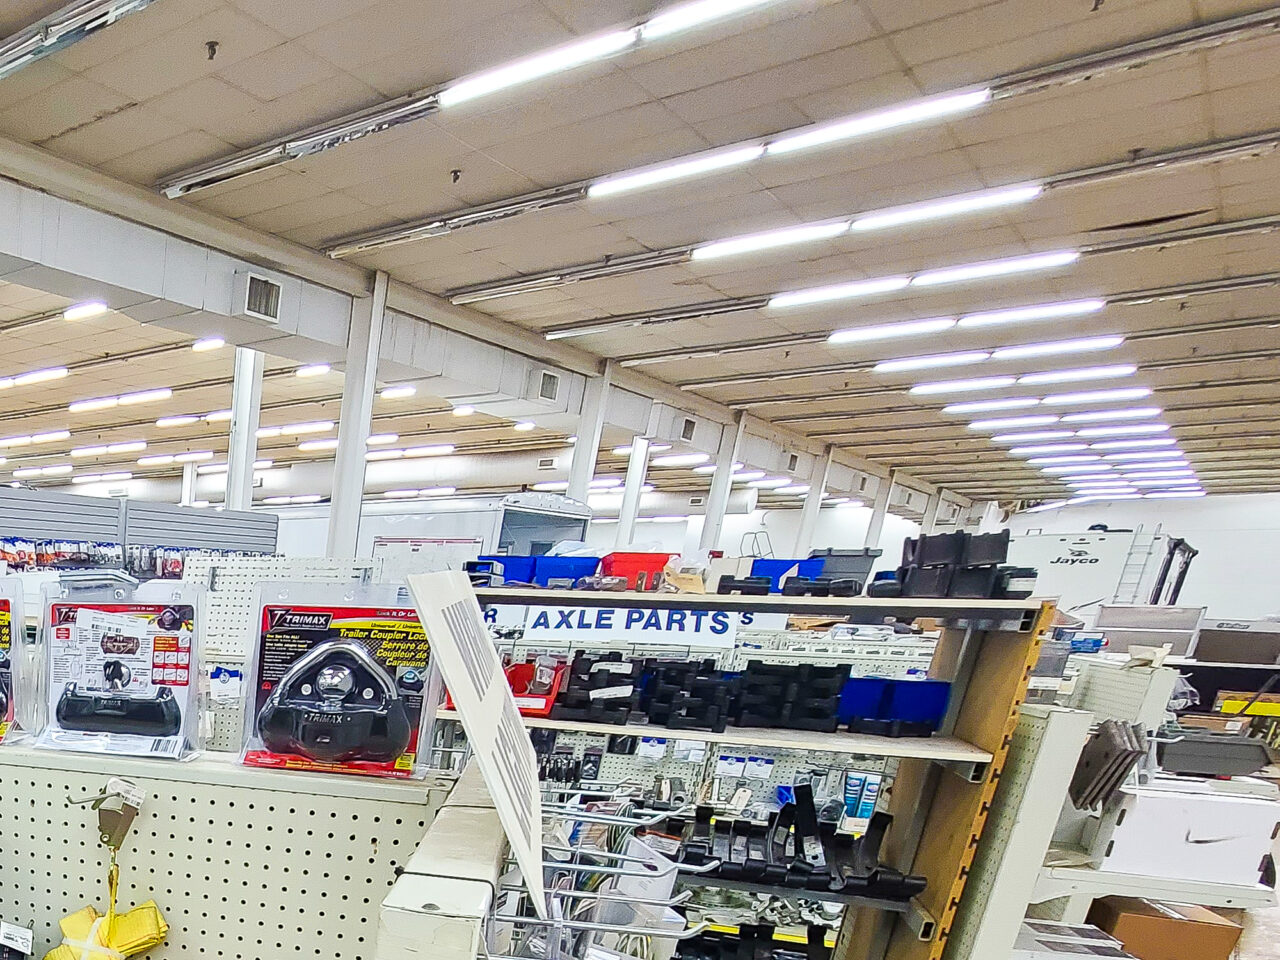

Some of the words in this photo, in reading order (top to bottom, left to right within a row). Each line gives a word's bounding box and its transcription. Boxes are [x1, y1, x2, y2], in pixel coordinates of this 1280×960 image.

[1049, 556, 1100, 566] Jayco
[285, 614, 327, 626] TRIMAX
[531, 608, 616, 631] AXLE
[625, 608, 731, 635] PARTS
[339, 629, 369, 639] Trailer
[370, 629, 407, 640] Coupler
[381, 641, 416, 651] Serrure
[417, 641, 429, 651] de
[376, 649, 415, 659] Coupleur
[416, 650, 428, 659] de
[385, 659, 427, 668] Caravane
[308, 713, 343, 725] TRIMAX
